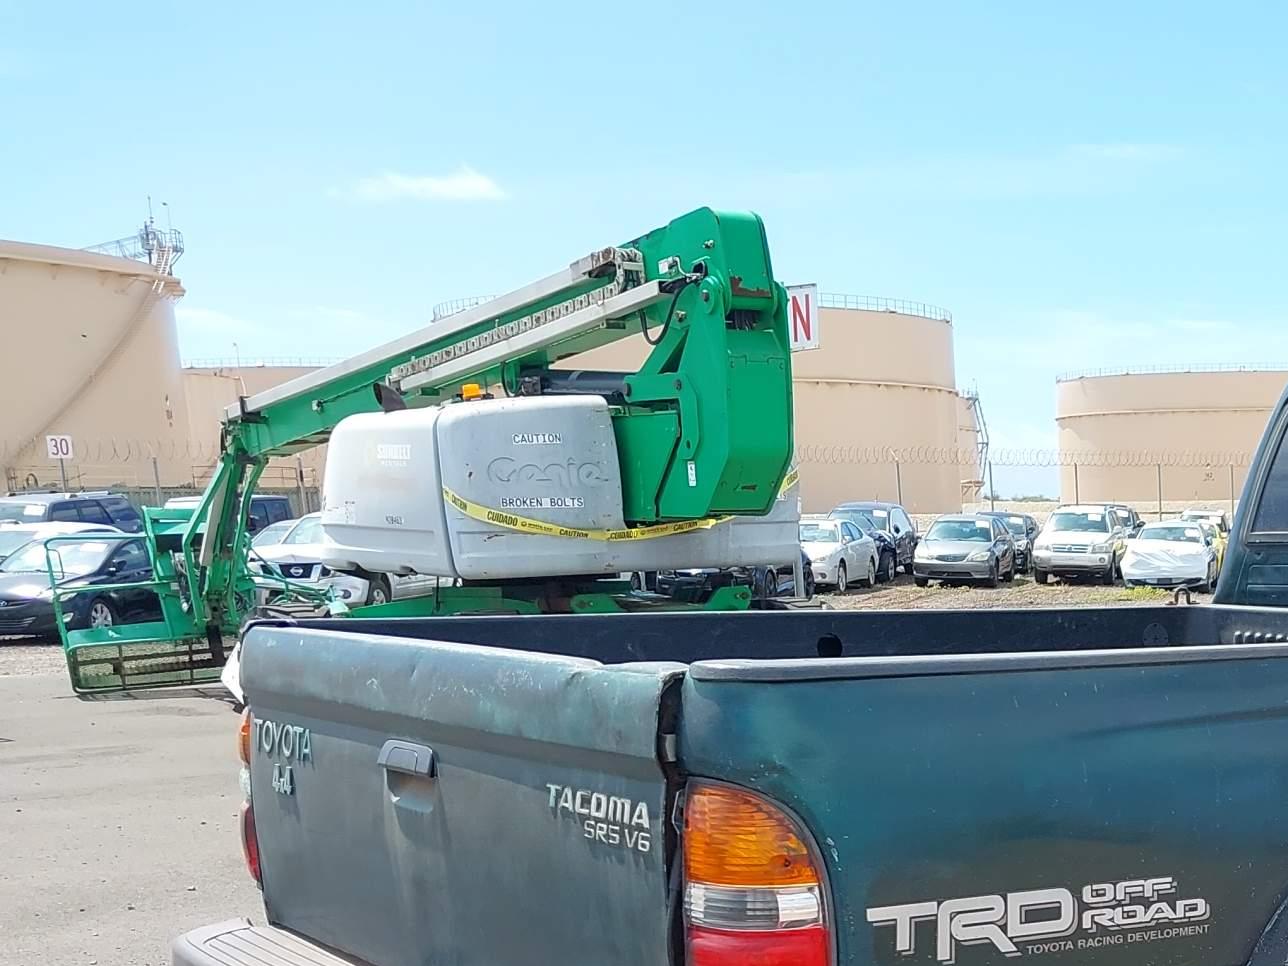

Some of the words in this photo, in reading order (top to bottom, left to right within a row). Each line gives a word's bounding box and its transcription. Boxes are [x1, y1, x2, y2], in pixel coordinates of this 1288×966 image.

[50, 438, 69, 456] 30
[512, 433, 561, 444] CAUTION
[487, 456, 609, 489] Genie
[486, 510, 519, 527] CUIDADO
[501, 497, 543, 508] BROKEN
[550, 497, 584, 508] BOLTS
[559, 528, 589, 539] CAUTION
[253, 718, 312, 761] TOYOTA
[546, 783, 650, 830] TACOMA
[584, 820, 620, 844] SR5
[624, 829, 651, 852] V6
[1081, 876, 1177, 906] OFF
[866, 887, 1078, 965] TRD
[1081, 898, 1211, 932] ROAD
[1026, 941, 1074, 956] TOYOTA
[1078, 933, 1124, 949] RACING
[1127, 924, 1211, 944] DEVELOPMENT
